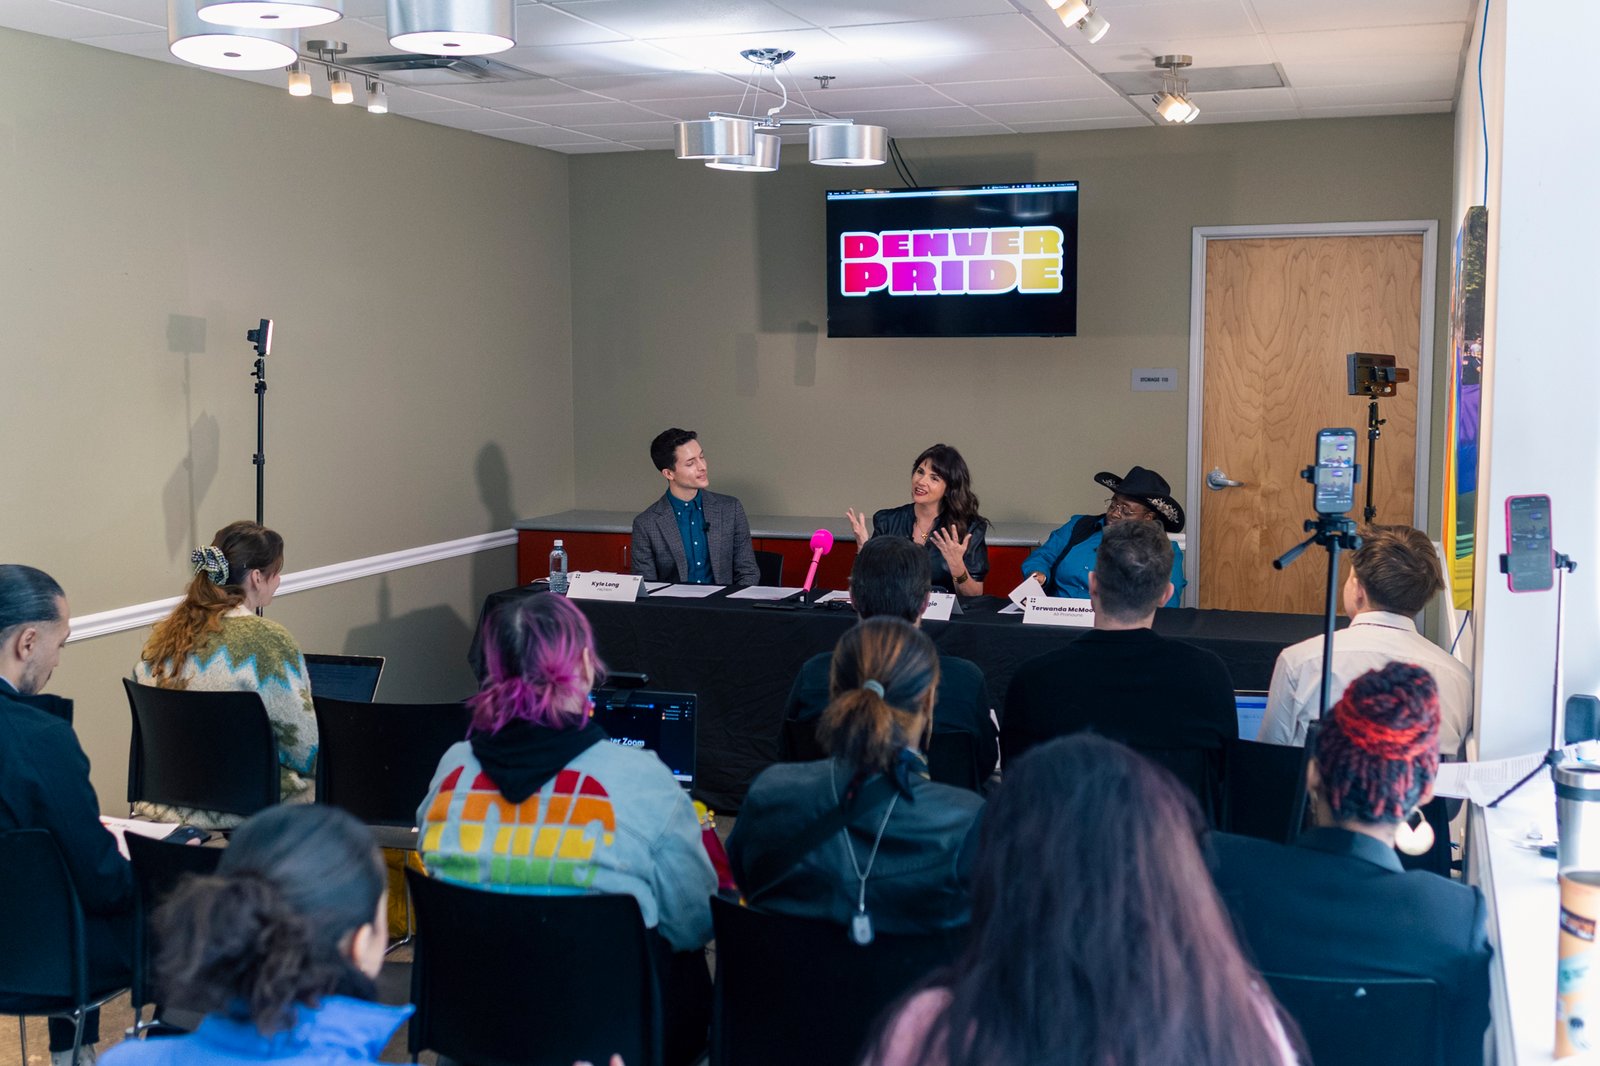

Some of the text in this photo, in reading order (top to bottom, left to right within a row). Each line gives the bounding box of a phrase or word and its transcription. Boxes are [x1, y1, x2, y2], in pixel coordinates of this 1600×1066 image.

[843, 229, 1061, 259] DENVER
[844, 258, 1060, 293] PRIDE
[605, 581, 620, 589] Long
[610, 737, 645, 747] ter Zoom
